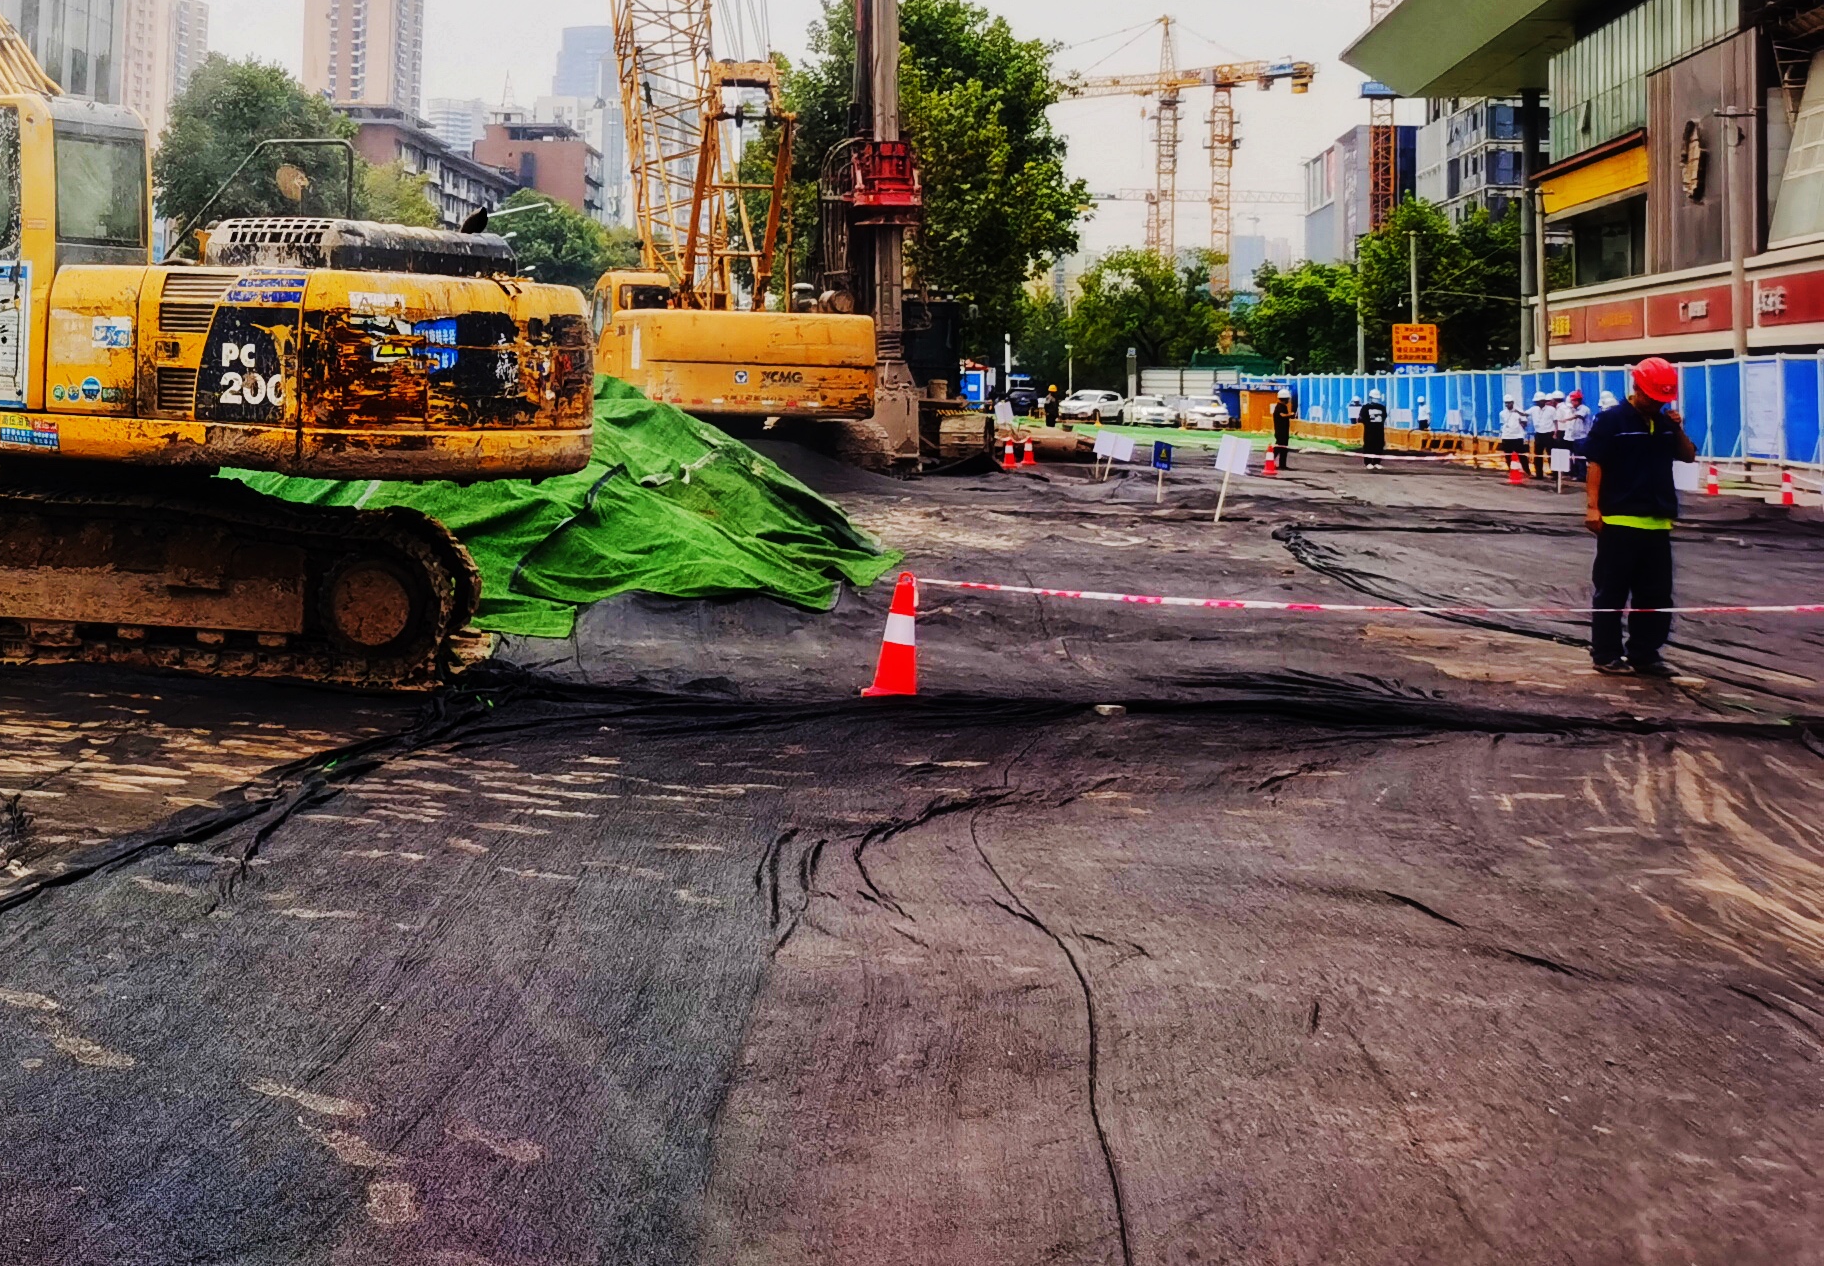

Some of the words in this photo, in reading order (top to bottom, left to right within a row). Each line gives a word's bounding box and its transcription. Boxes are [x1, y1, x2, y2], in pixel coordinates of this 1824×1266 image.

[221, 342, 256, 368] PC
[219, 371, 285, 407] 200
[759, 371, 803, 384] XCMG
